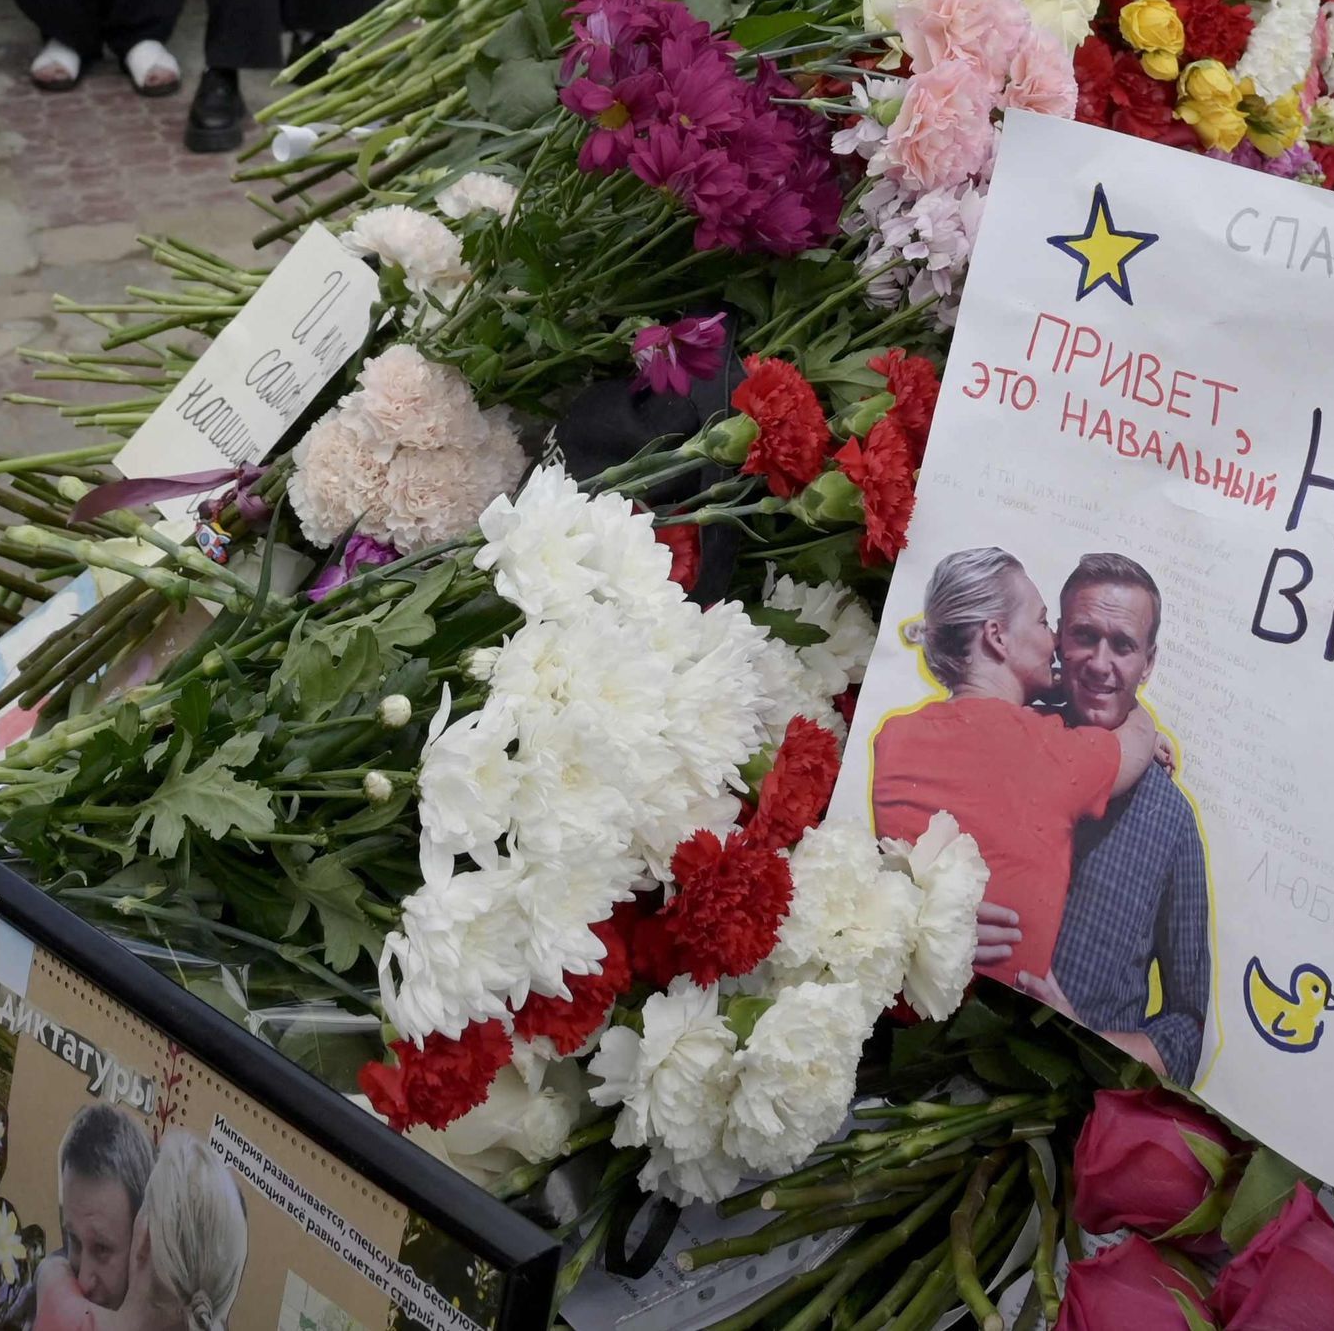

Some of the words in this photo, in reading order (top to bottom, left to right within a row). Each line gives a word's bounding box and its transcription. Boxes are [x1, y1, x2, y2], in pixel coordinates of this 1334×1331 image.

[961, 360, 1039, 414] ЭТО
[1059, 390, 1279, 512] НАВАЛЬНЫЙ
[1026, 312, 1253, 457] ПРИВЕТ,
[210, 1138, 224, 1156] но
[224, 1148, 286, 1207] революция
[287, 1202, 307, 1223] всё
[306, 1219, 342, 1254] равно
[343, 1247, 390, 1292] сметает
[390, 1286, 436, 1328] старый
[214, 1113, 263, 1165] Империя
[263, 1156, 347, 1238] разваливается,
[349, 1227, 422, 1292] спецслужбы
